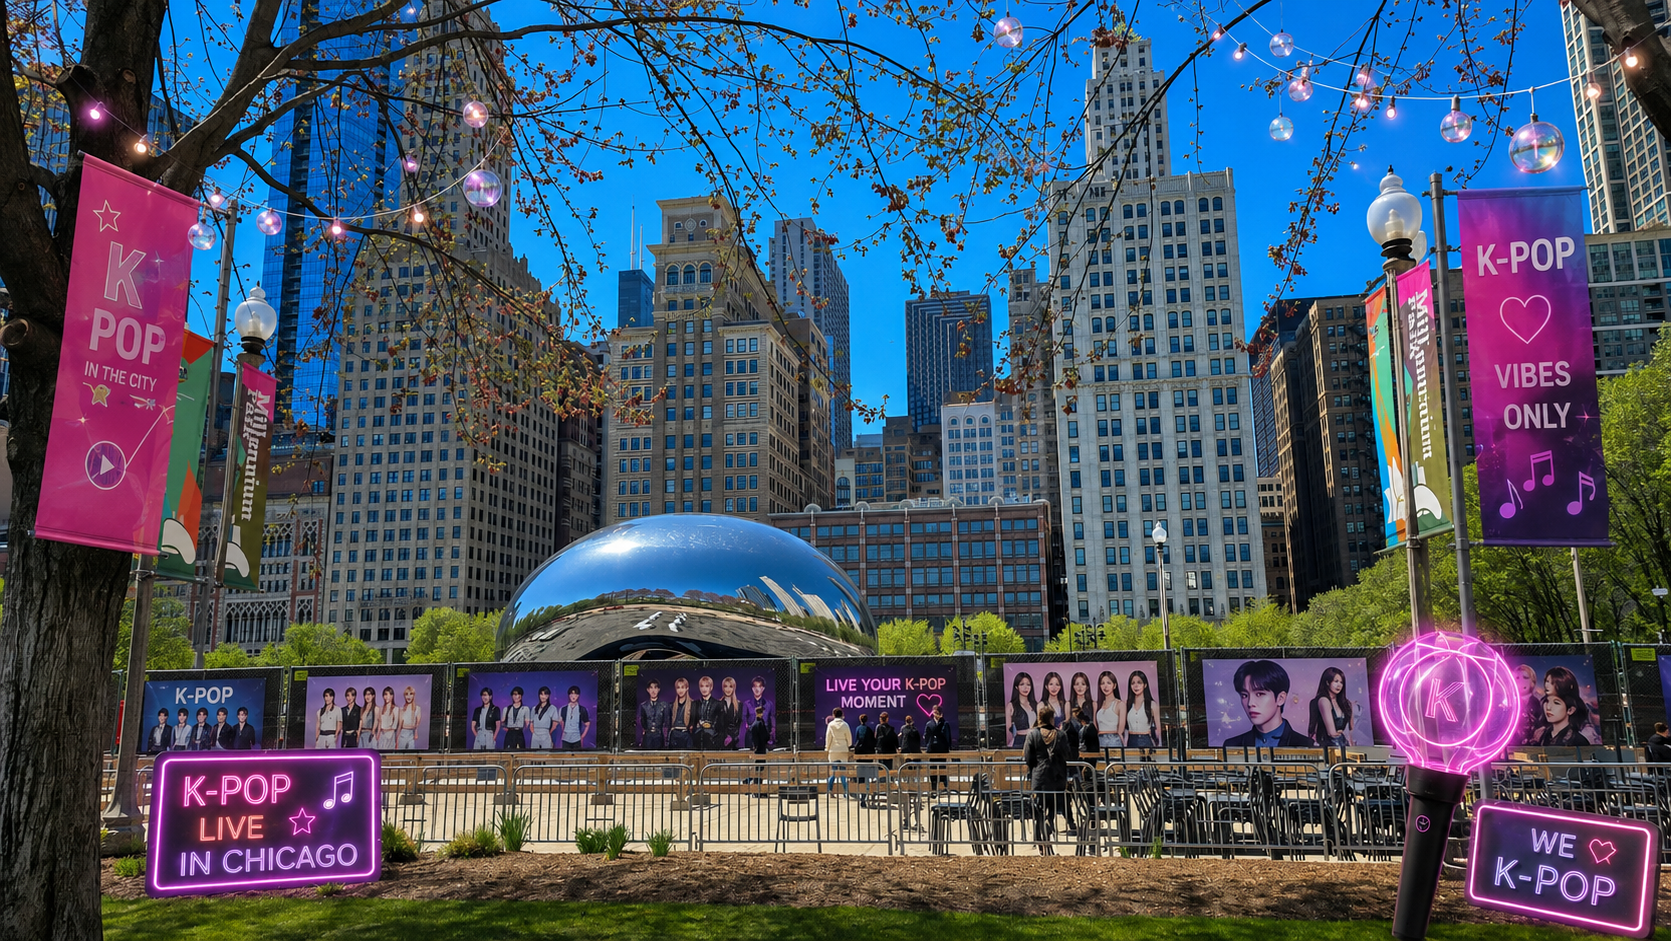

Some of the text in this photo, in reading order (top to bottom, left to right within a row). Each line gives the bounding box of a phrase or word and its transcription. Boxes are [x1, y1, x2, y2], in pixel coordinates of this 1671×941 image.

[1476, 236, 1576, 277] K-POP
[104, 241, 146, 309] K
[89, 307, 166, 365] POP
[84, 361, 157, 392] IN THE CITY
[1495, 361, 1571, 389] VIBES
[1503, 402, 1571, 430] ONLY
[241, 389, 271, 521] Millennium
[175, 686, 233, 705] K-POP
[826, 677, 947, 692] LIVE YOUR K-POP
[1425, 677, 1464, 723] K
[840, 694, 906, 709] MOMENT
[183, 774, 292, 807] K-POP
[200, 814, 264, 841] LIVE
[1531, 828, 1577, 859] WE
[180, 843, 358, 876] IN CHICAGO
[1493, 856, 1616, 906] K-POP
